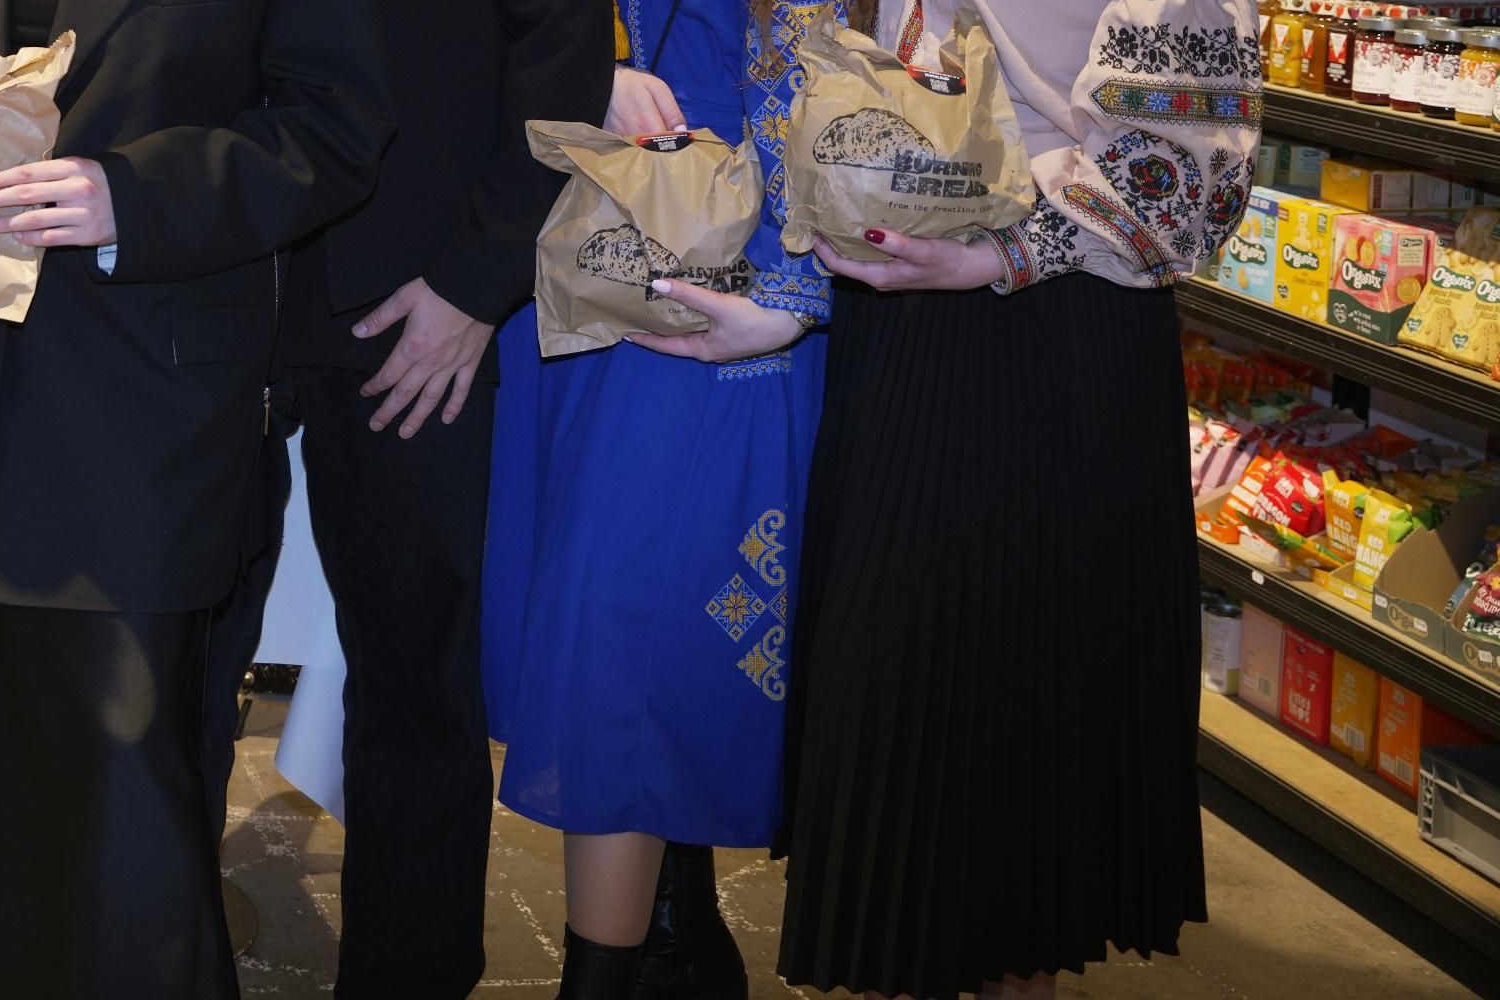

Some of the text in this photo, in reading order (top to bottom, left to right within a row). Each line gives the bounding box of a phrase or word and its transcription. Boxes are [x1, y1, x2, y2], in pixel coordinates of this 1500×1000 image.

[894, 149, 982, 176] BURNING
[891, 173, 990, 198] BREAD
[889, 201, 909, 209] from
[933, 206, 976, 214] frontline
[1229, 236, 1266, 262] Organix
[1283, 244, 1318, 268] Organix
[1342, 260, 1382, 289] Organix
[1432, 266, 1475, 290] Organix
